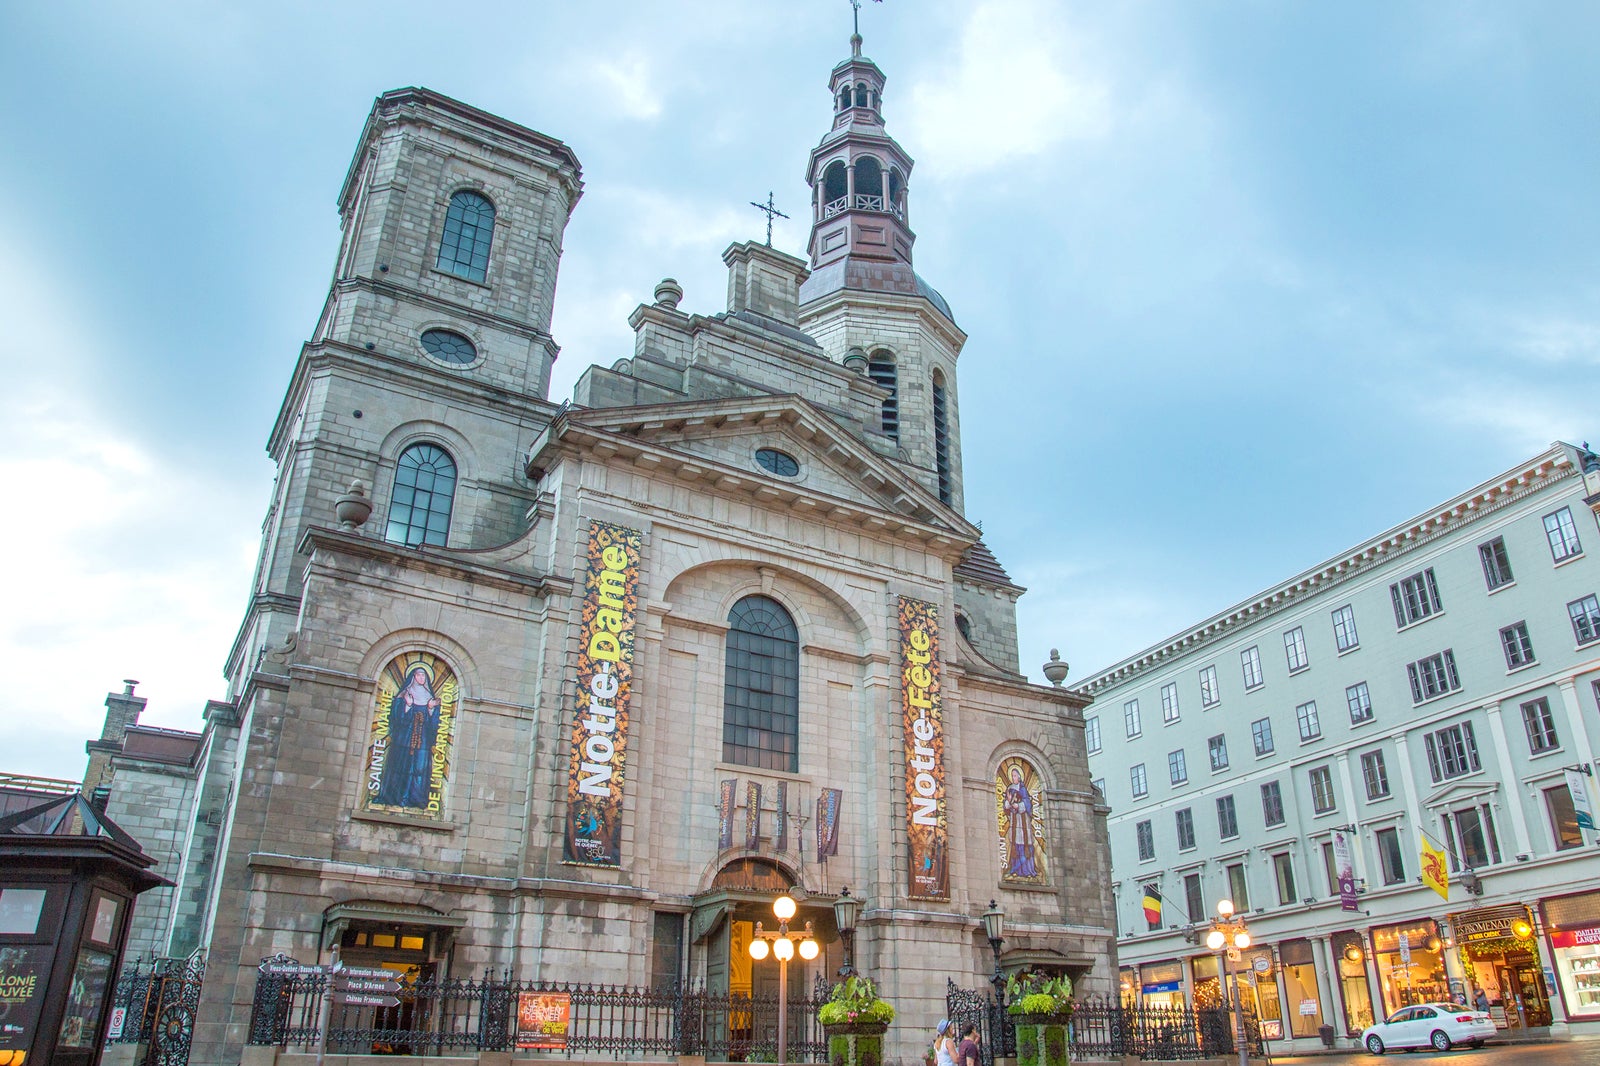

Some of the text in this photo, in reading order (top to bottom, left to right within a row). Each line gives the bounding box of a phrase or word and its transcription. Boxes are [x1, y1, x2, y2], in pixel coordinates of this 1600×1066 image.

[579, 545, 628, 798] Notre-Dame
[368, 689, 394, 791] SAINTE MARIE
[906, 629, 937, 827] Notre-Fête
[427, 681, 456, 812] DE L'INCARNATION
[721, 785, 731, 819] Culture
[826, 791, 835, 826] Histoire
[1031, 789, 1043, 838] DE LAVAL
[996, 776, 1008, 869] SAINT FRANÇOIS
[586, 846, 605, 858] 350
[1465, 918, 1513, 933] PROMENAD
[349, 968, 372, 976] Information
[372, 970, 394, 978] touristique
[363, 982, 385, 990] D'Armes
[363, 996, 384, 1005] Frontenac
[520, 1006, 565, 1015] JUGEMENT
[528, 999, 539, 1008] LE
[525, 1014, 560, 1022] DERNIER
